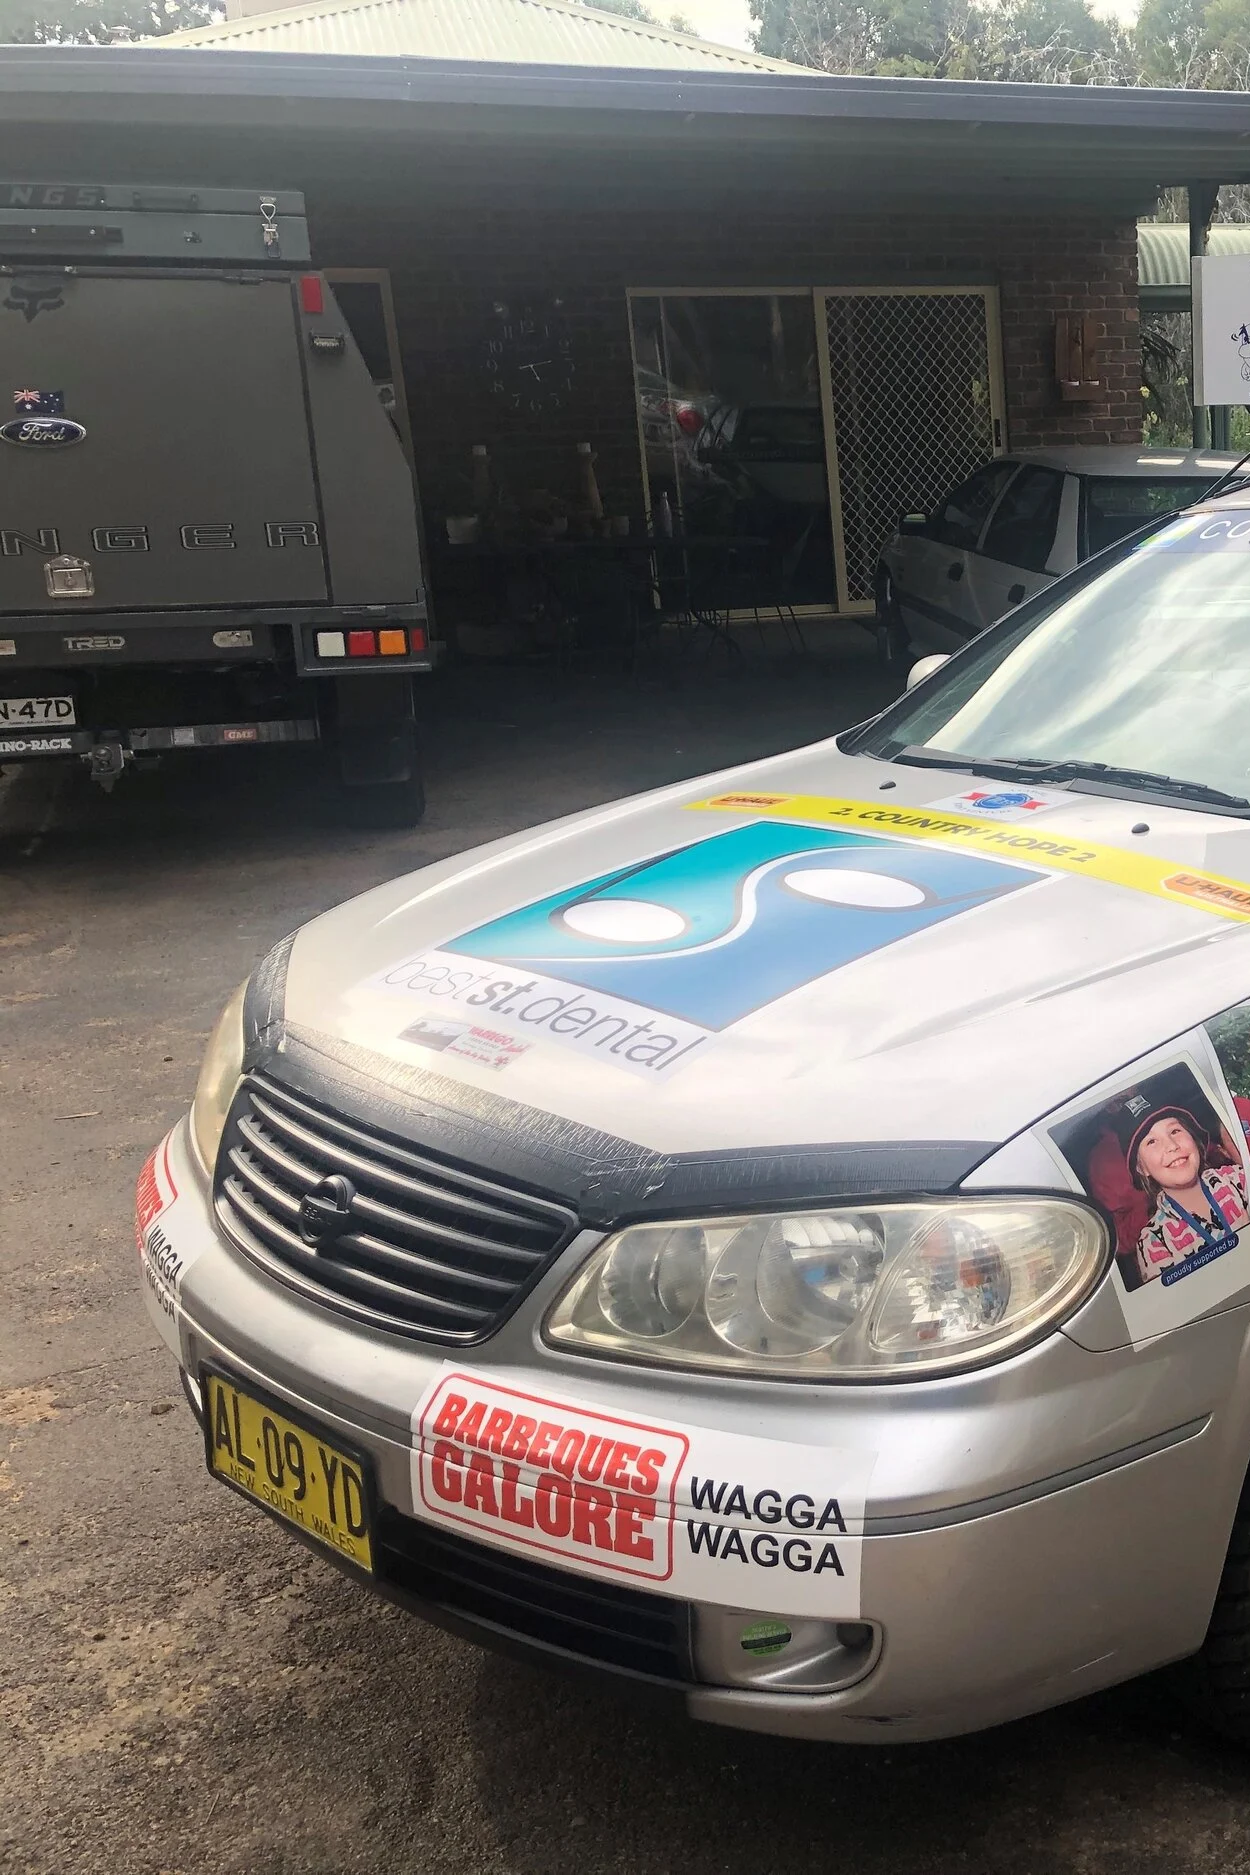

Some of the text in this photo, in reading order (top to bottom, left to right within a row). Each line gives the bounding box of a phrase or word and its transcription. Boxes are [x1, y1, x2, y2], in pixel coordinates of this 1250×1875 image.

[18, 421, 66, 442] Ford
[63, 635, 126, 651] TRED
[857, 810, 991, 836] COUNTRY
[984, 831, 1078, 856] HOPE
[1069, 852, 1097, 863] 2
[147, 1224, 184, 1290] WAGGA
[1165, 1237, 1237, 1284] proudly supported by
[432, 1392, 667, 1496] BARBEQUES
[229, 1462, 357, 1556] NEW SOUTH WALES
[431, 1439, 658, 1562] GALORE
[689, 1475, 848, 1533] WAGGA
[686, 1519, 845, 1577] WAGGA
